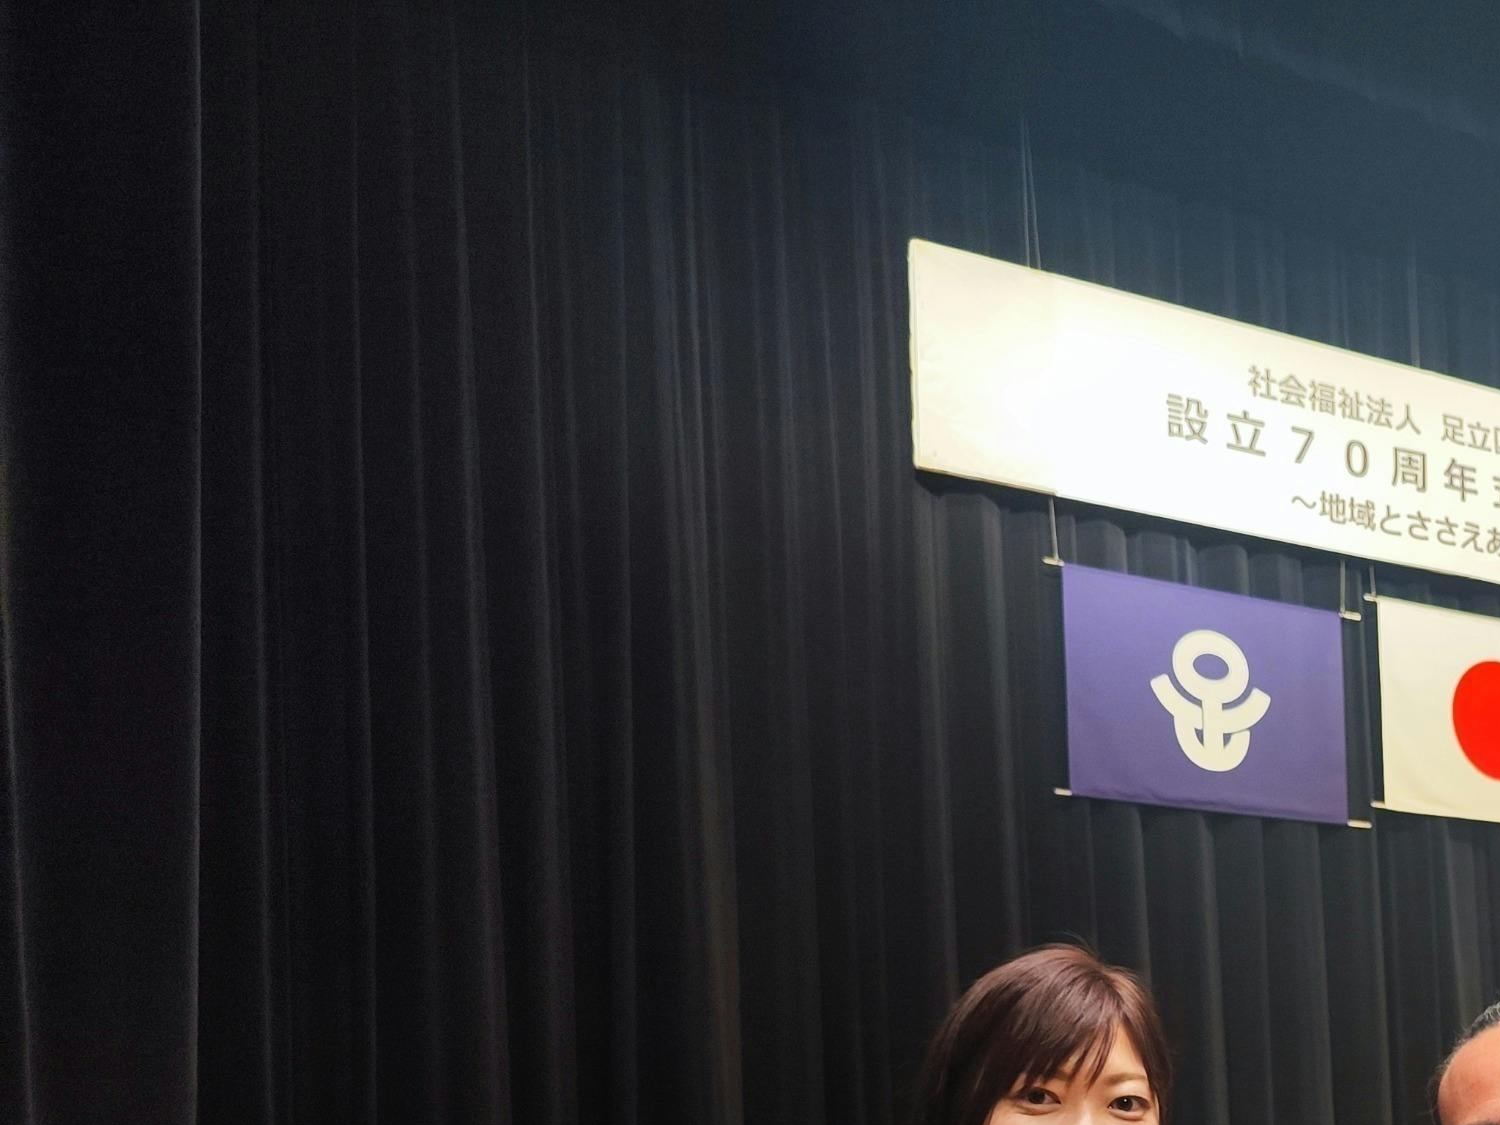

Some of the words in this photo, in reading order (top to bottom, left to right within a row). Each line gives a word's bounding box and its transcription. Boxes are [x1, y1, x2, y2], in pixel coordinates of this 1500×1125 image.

[1247, 364, 1422, 435] 社会福祉法人
